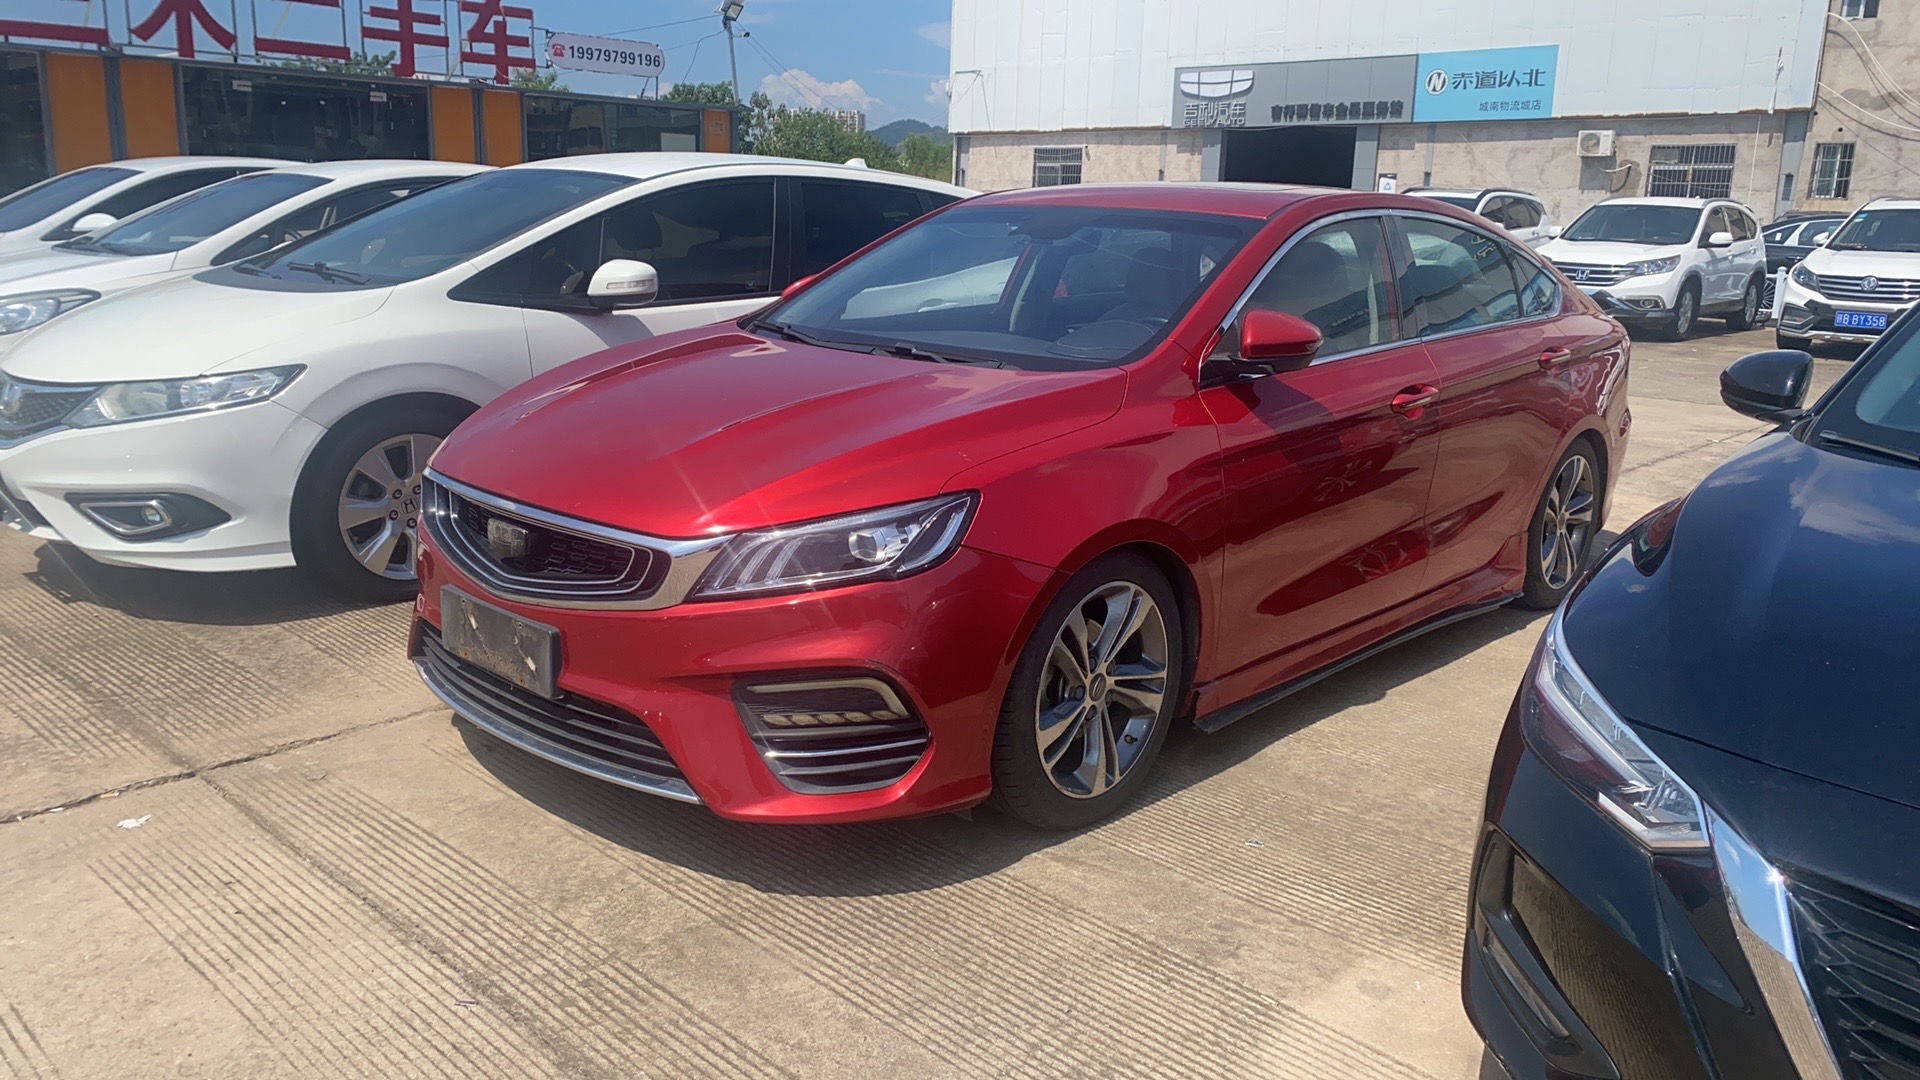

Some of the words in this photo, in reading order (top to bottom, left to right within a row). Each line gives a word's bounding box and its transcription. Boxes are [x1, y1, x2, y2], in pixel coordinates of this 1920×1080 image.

[0, 0, 537, 85] 木二手车
[568, 45, 661, 68] 19979799196
[1451, 68, 1546, 90] 赤道以北
[1184, 101, 1246, 118] 吉利汽车
[1479, 99, 1541, 112] 城南物流城店
[1183, 118, 1215, 127] GEELY
[1217, 117, 1245, 126] AUTO
